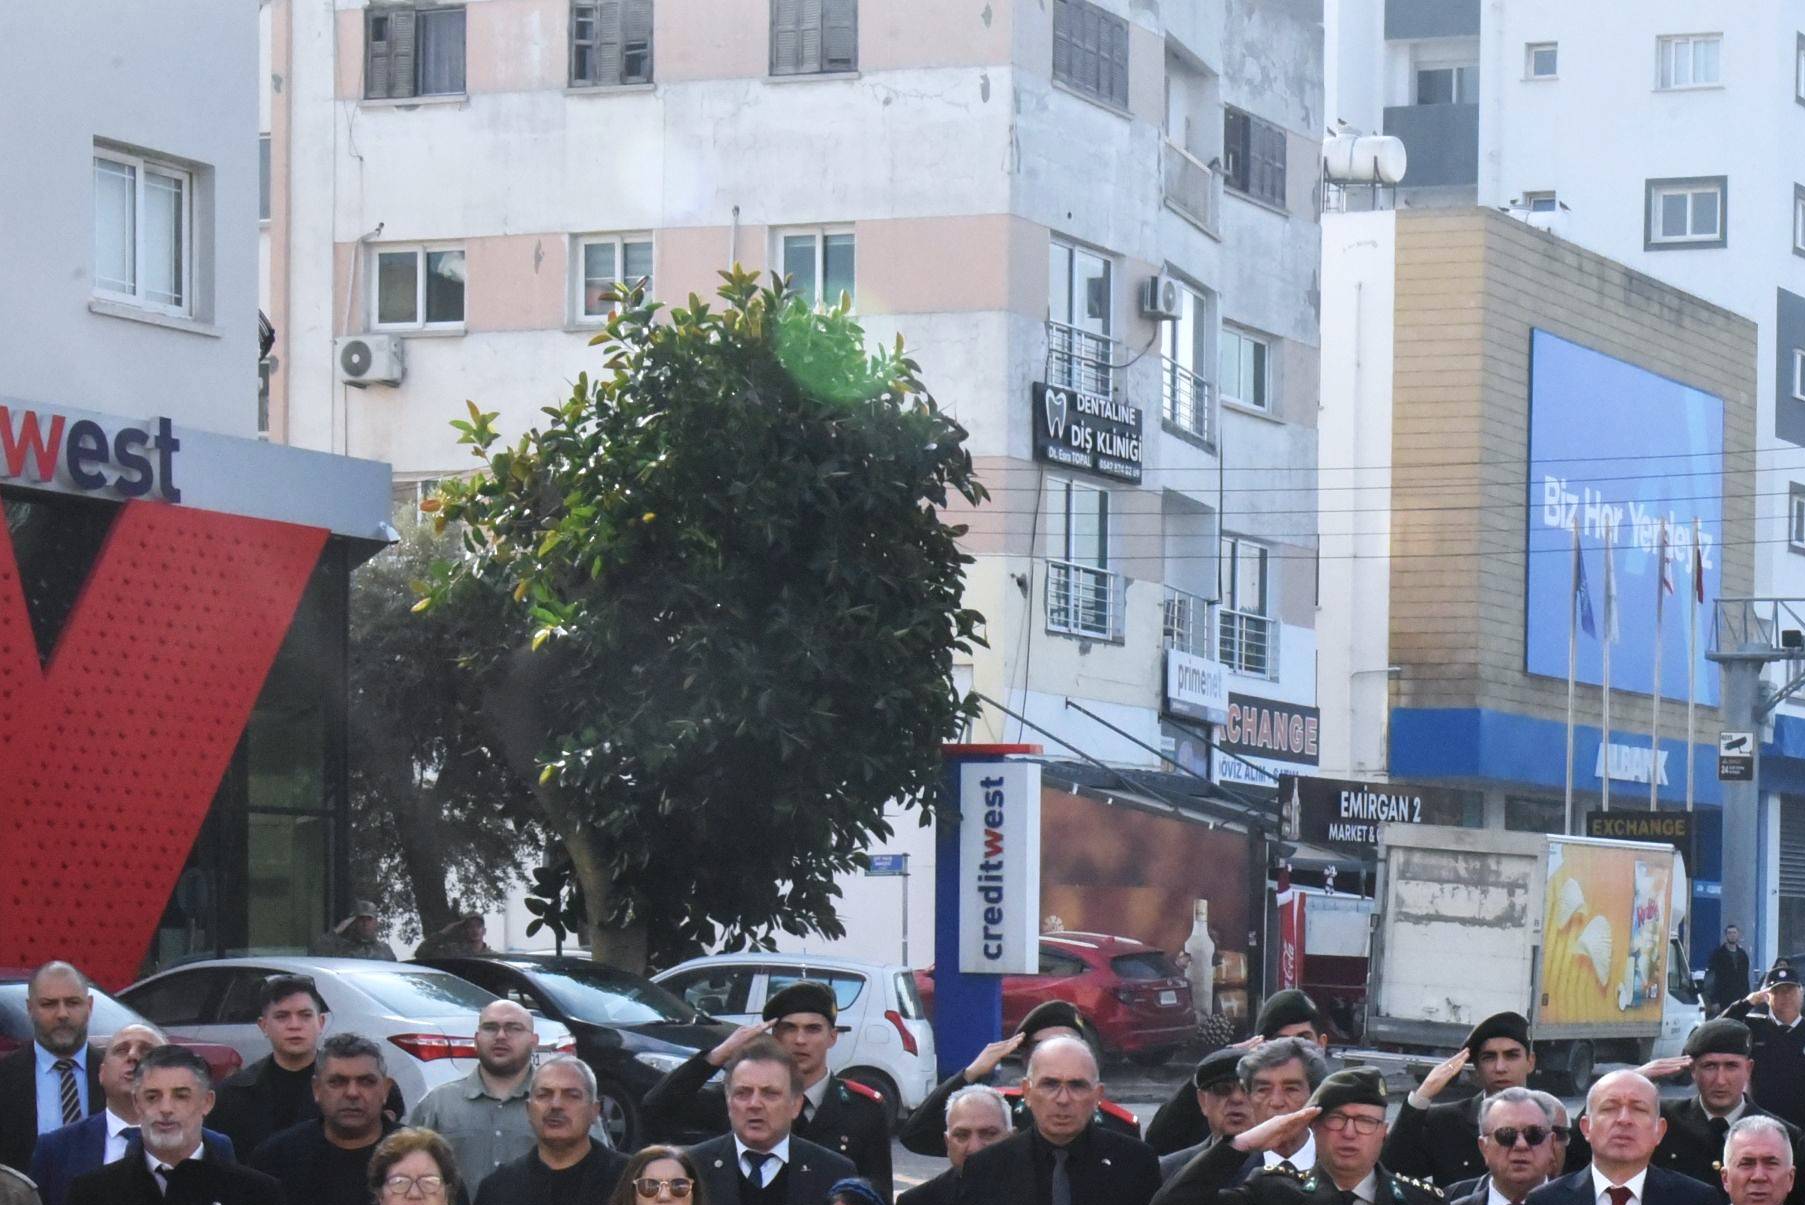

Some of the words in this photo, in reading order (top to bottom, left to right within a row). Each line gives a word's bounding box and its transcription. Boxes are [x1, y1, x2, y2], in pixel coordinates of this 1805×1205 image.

[1077, 394, 1136, 425] DENTALINE
[1071, 420, 1093, 453] DİŞ
[1097, 427, 1142, 462] KLİNİĞİ
[1544, 475, 1580, 533] Biz
[1177, 659, 1222, 698] primenet
[1219, 757, 1242, 780] ÖVİZ
[1340, 785, 1409, 823] EMİRGAN
[1412, 797, 1423, 823] 2
[1329, 823, 1368, 842] MARKET
[1592, 818, 1687, 837] EXCHANGE
[978, 776, 1004, 960] creditwest
